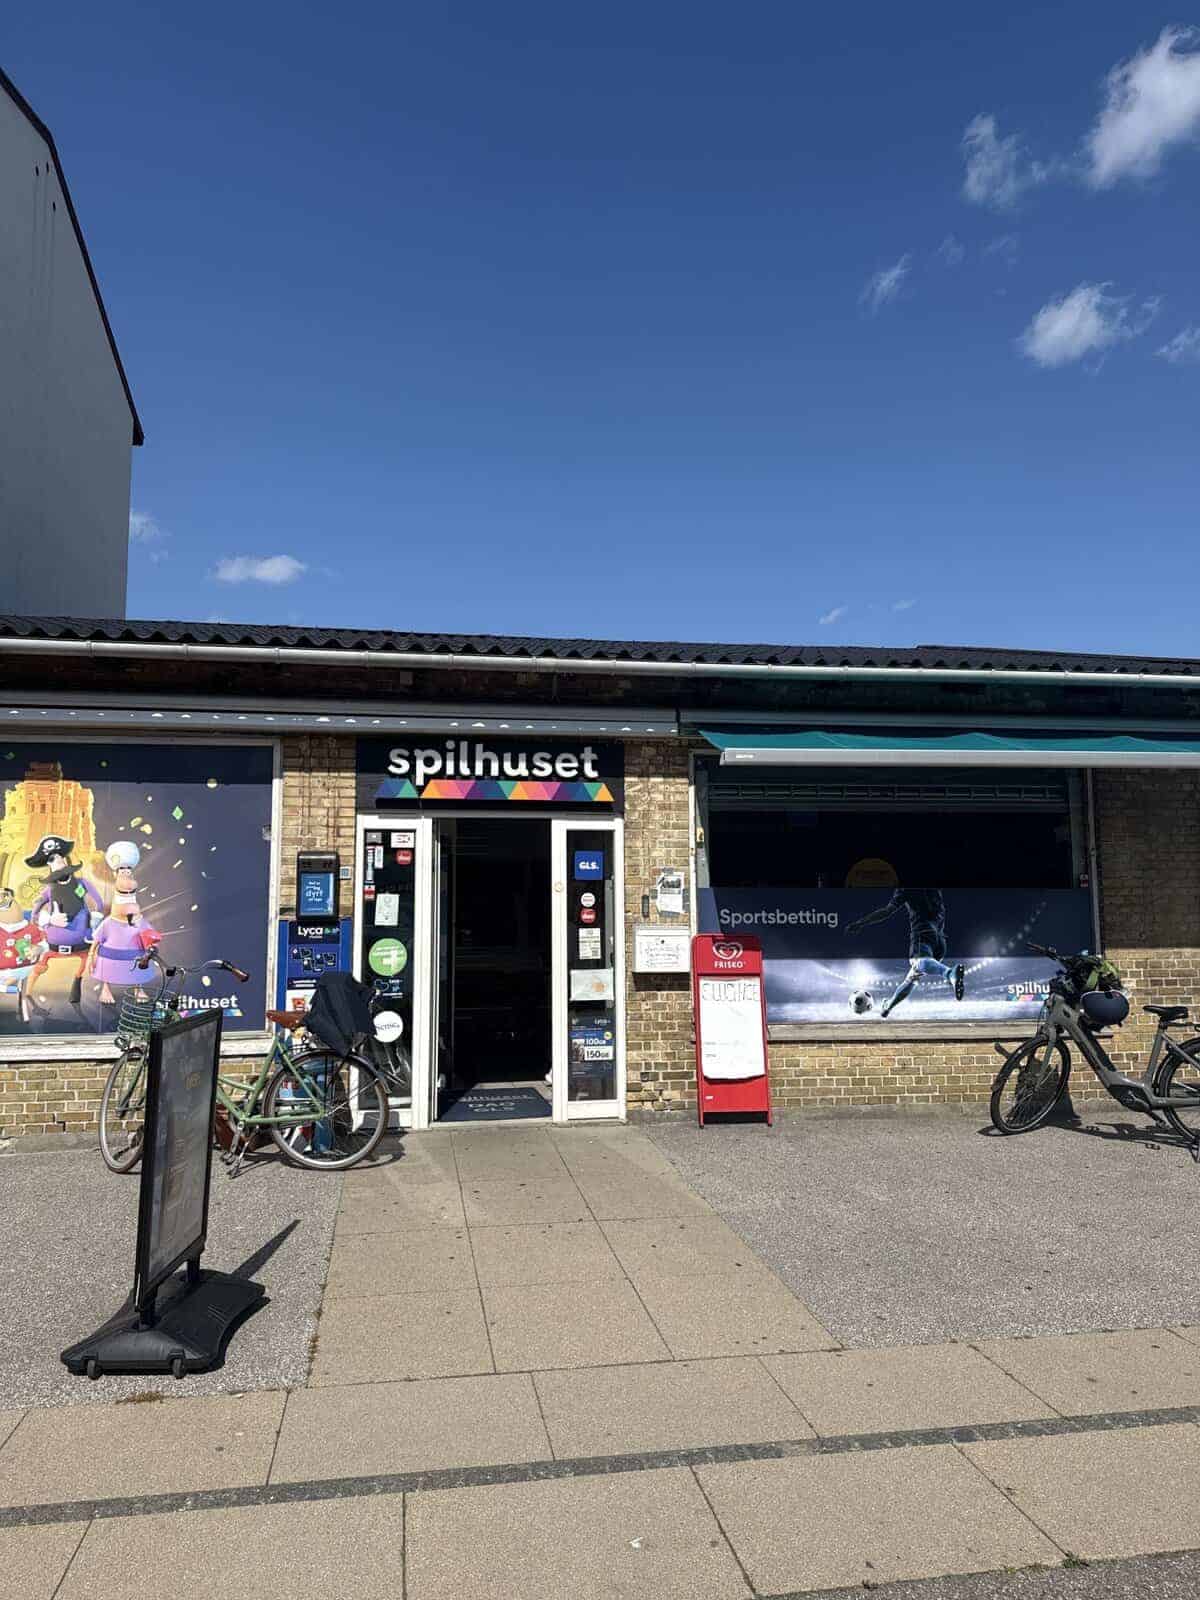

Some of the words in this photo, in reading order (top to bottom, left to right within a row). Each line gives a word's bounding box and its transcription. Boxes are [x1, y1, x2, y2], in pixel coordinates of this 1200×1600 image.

[387, 740, 599, 786] spilhuset
[720, 908, 838, 928] Sportsbetting
[297, 925, 323, 937] Lyca
[714, 961, 744, 969] FRISKO
